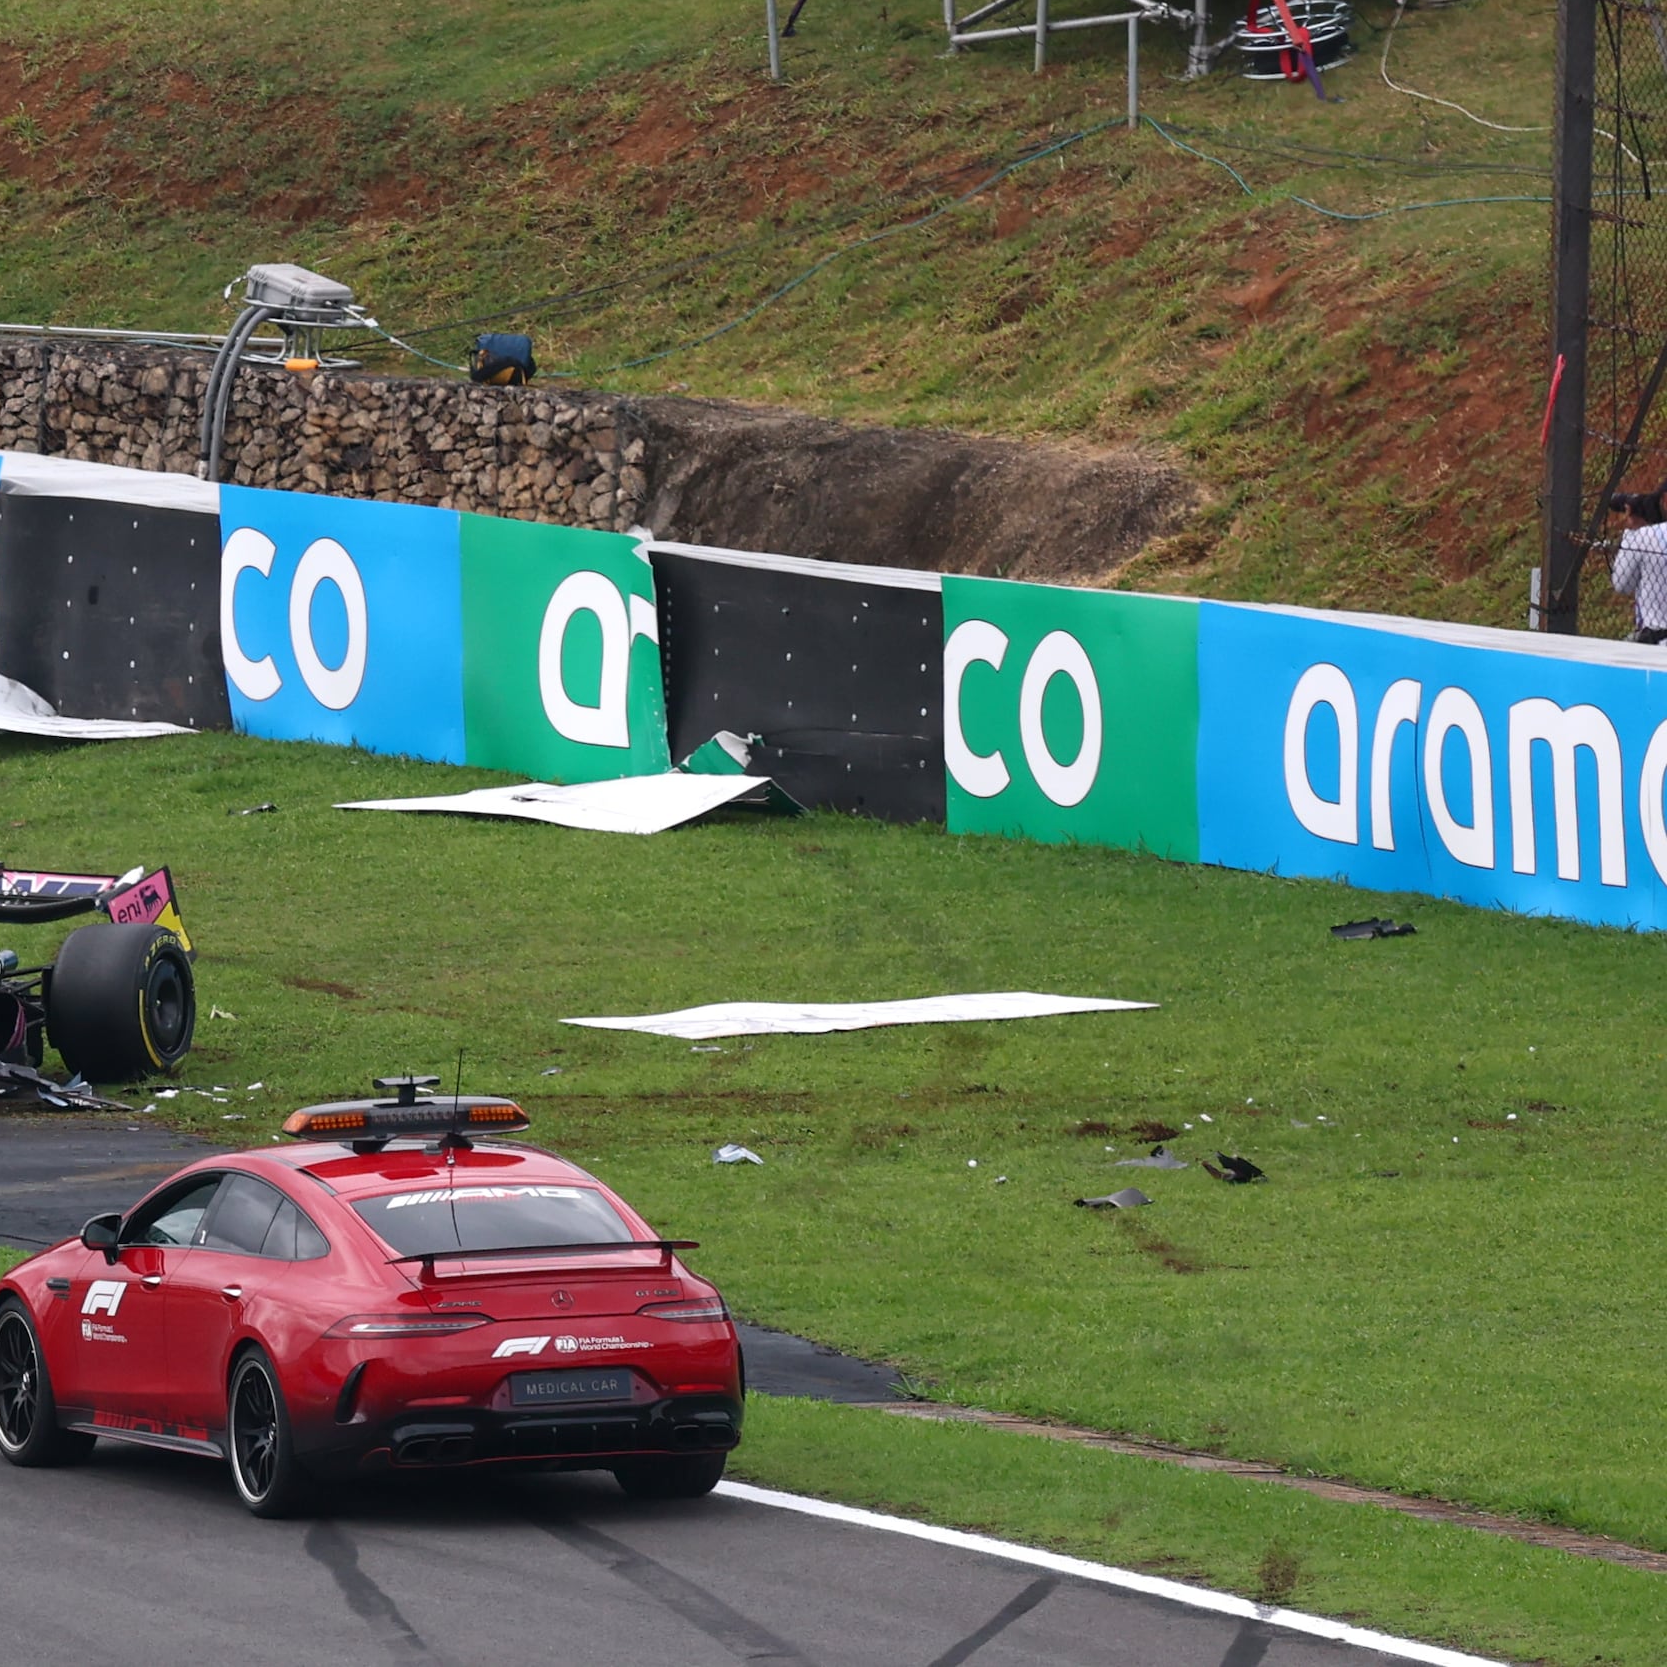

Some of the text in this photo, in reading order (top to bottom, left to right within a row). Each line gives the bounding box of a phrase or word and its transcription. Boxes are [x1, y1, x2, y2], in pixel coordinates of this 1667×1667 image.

[117, 895, 142, 923] eni
[591, 1336, 619, 1344] Formula
[579, 1343, 602, 1351] World
[526, 1379, 618, 1396] MEDICAL CAR
